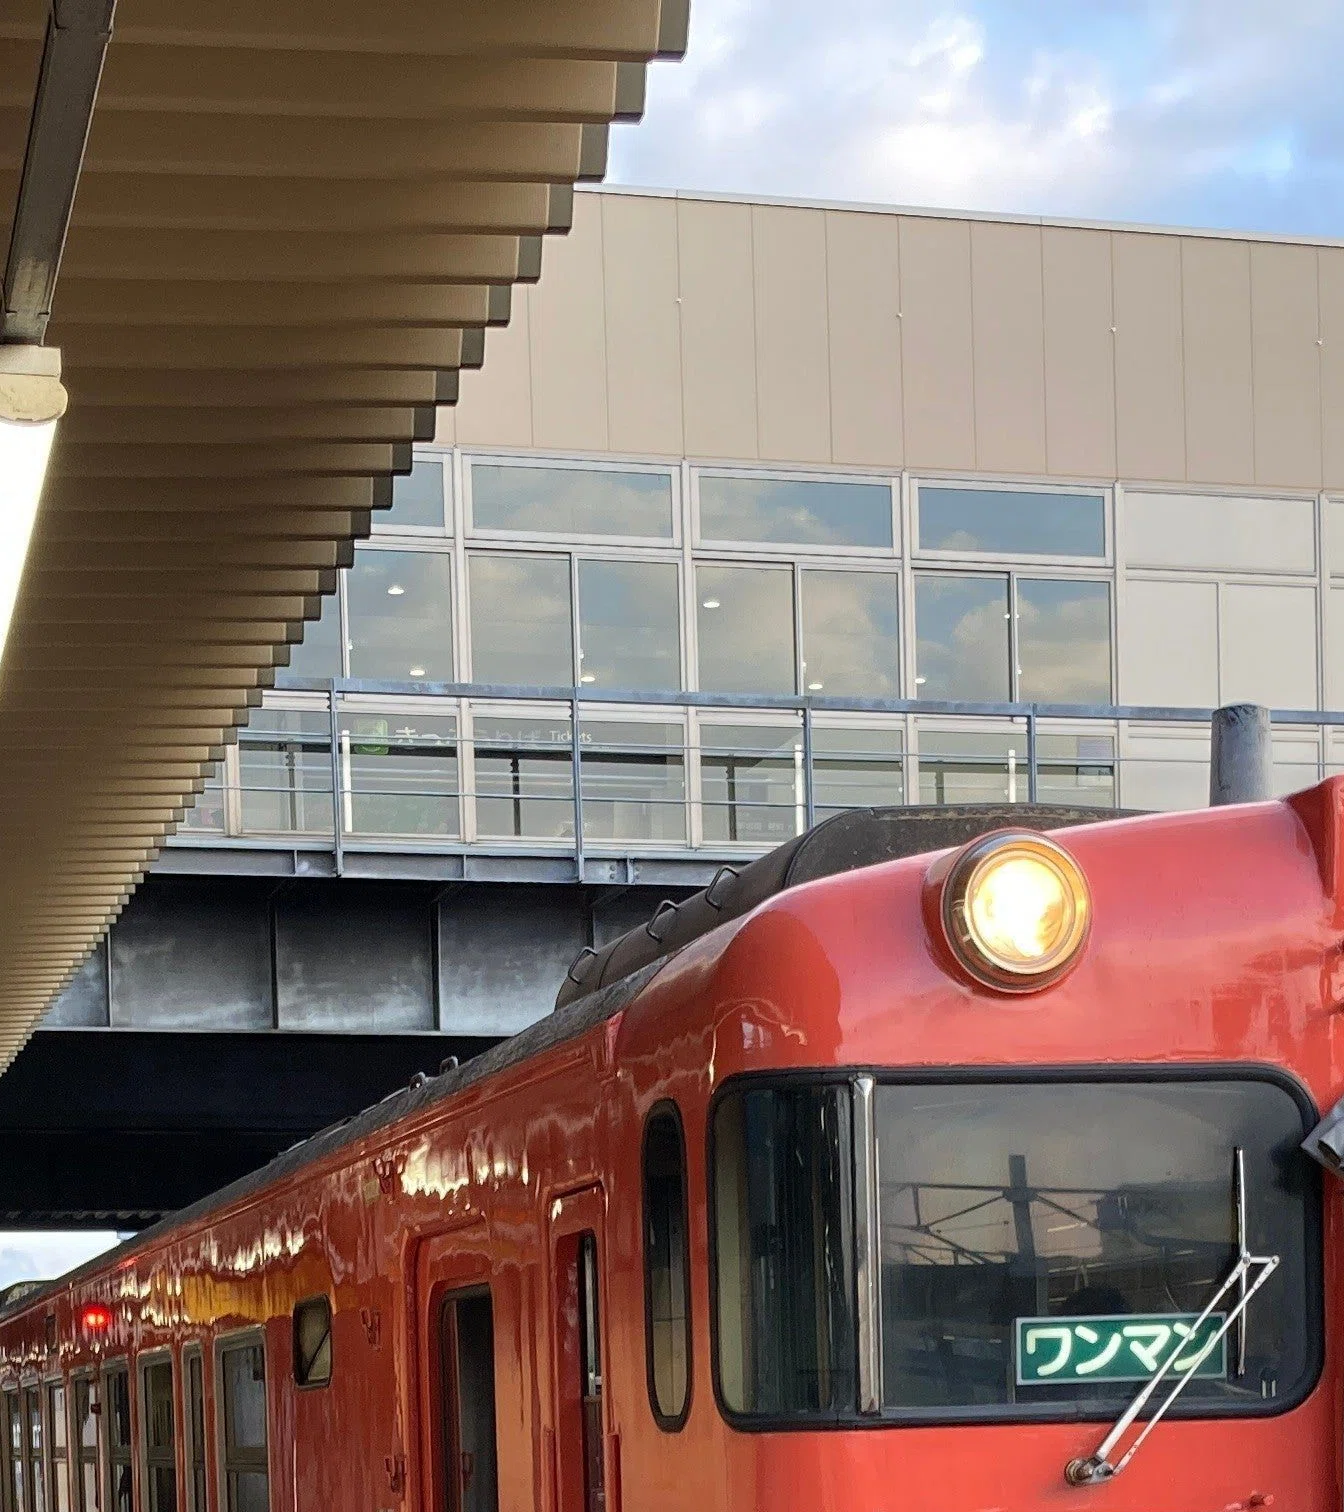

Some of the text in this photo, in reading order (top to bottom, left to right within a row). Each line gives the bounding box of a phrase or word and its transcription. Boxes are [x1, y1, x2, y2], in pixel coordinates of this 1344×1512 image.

[549, 730, 592, 743] Tickts
[1026, 1322, 1218, 1377] ワンマン
